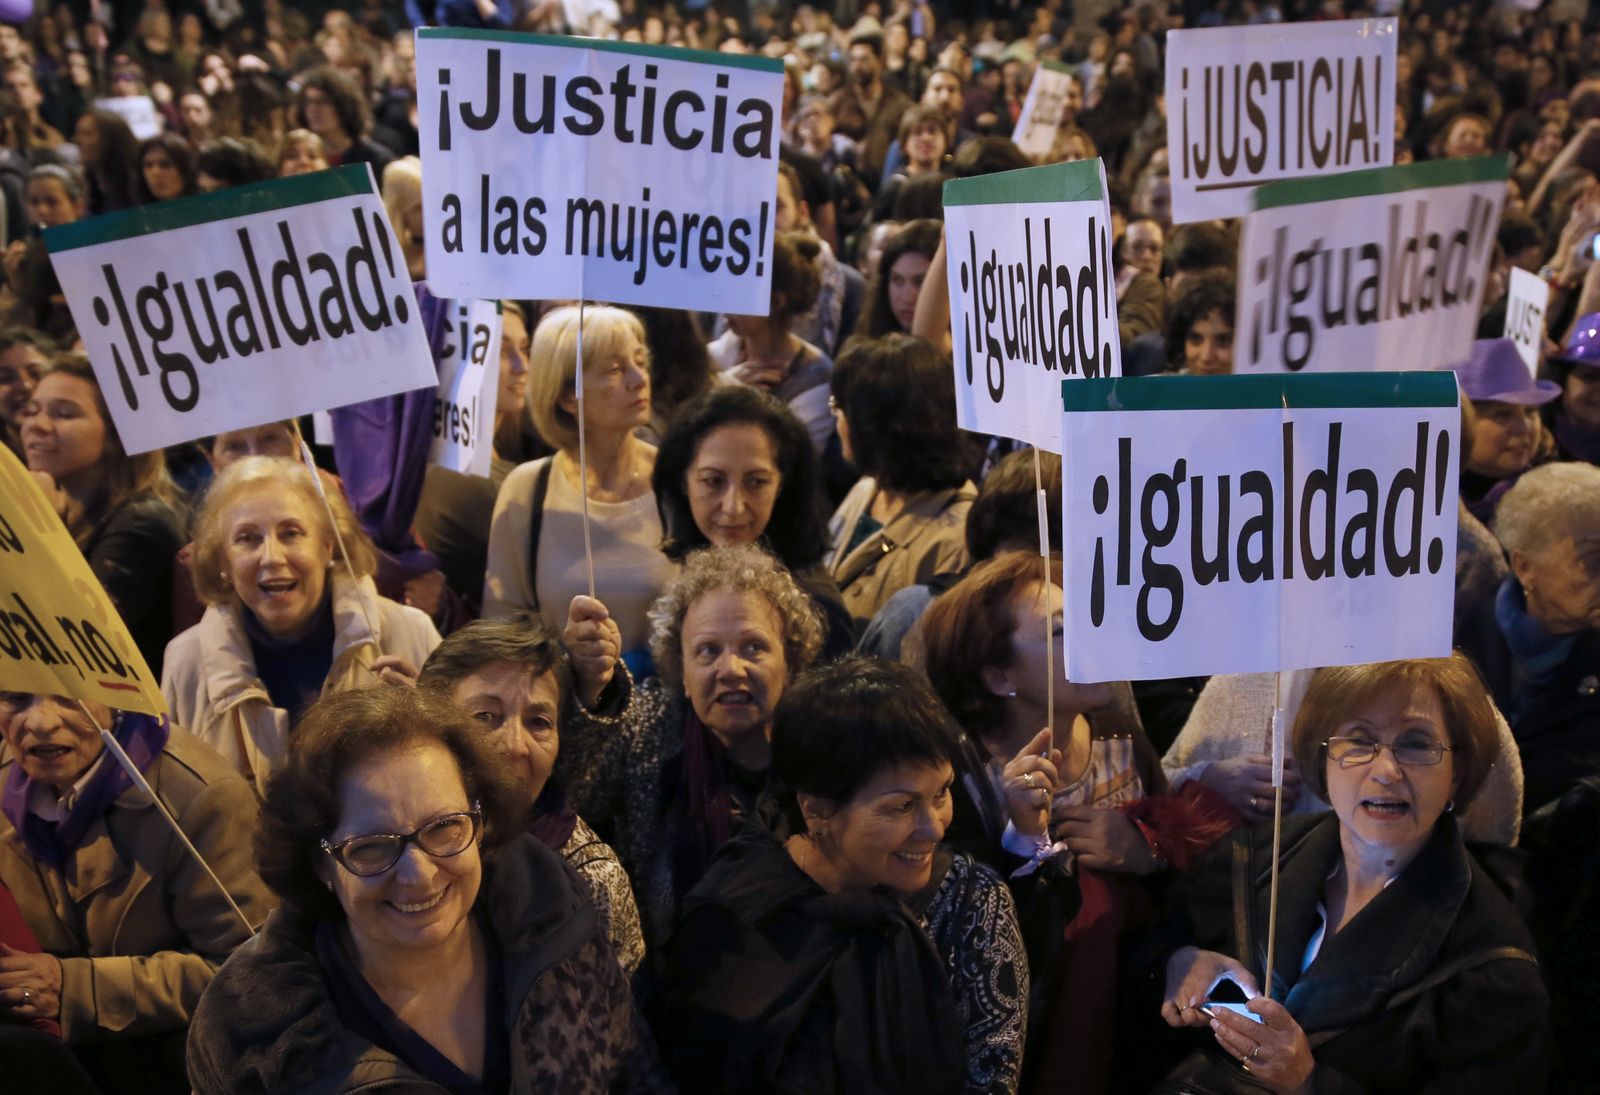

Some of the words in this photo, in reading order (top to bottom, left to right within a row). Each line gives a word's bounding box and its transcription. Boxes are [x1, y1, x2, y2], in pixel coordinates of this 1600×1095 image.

[438, 48, 773, 159] ¡Justicia
[1182, 55, 1382, 179] ¡JUSTICIA!
[92, 206, 409, 412] ¡Igualdad!
[441, 193, 463, 253] a
[480, 174, 547, 256] las
[565, 187, 769, 286] mujeres!
[961, 216, 1112, 403] ¡Igualdad!
[1248, 194, 1496, 373] ¡Igualdad!
[1090, 421, 1450, 642] ¡Igualdad!
